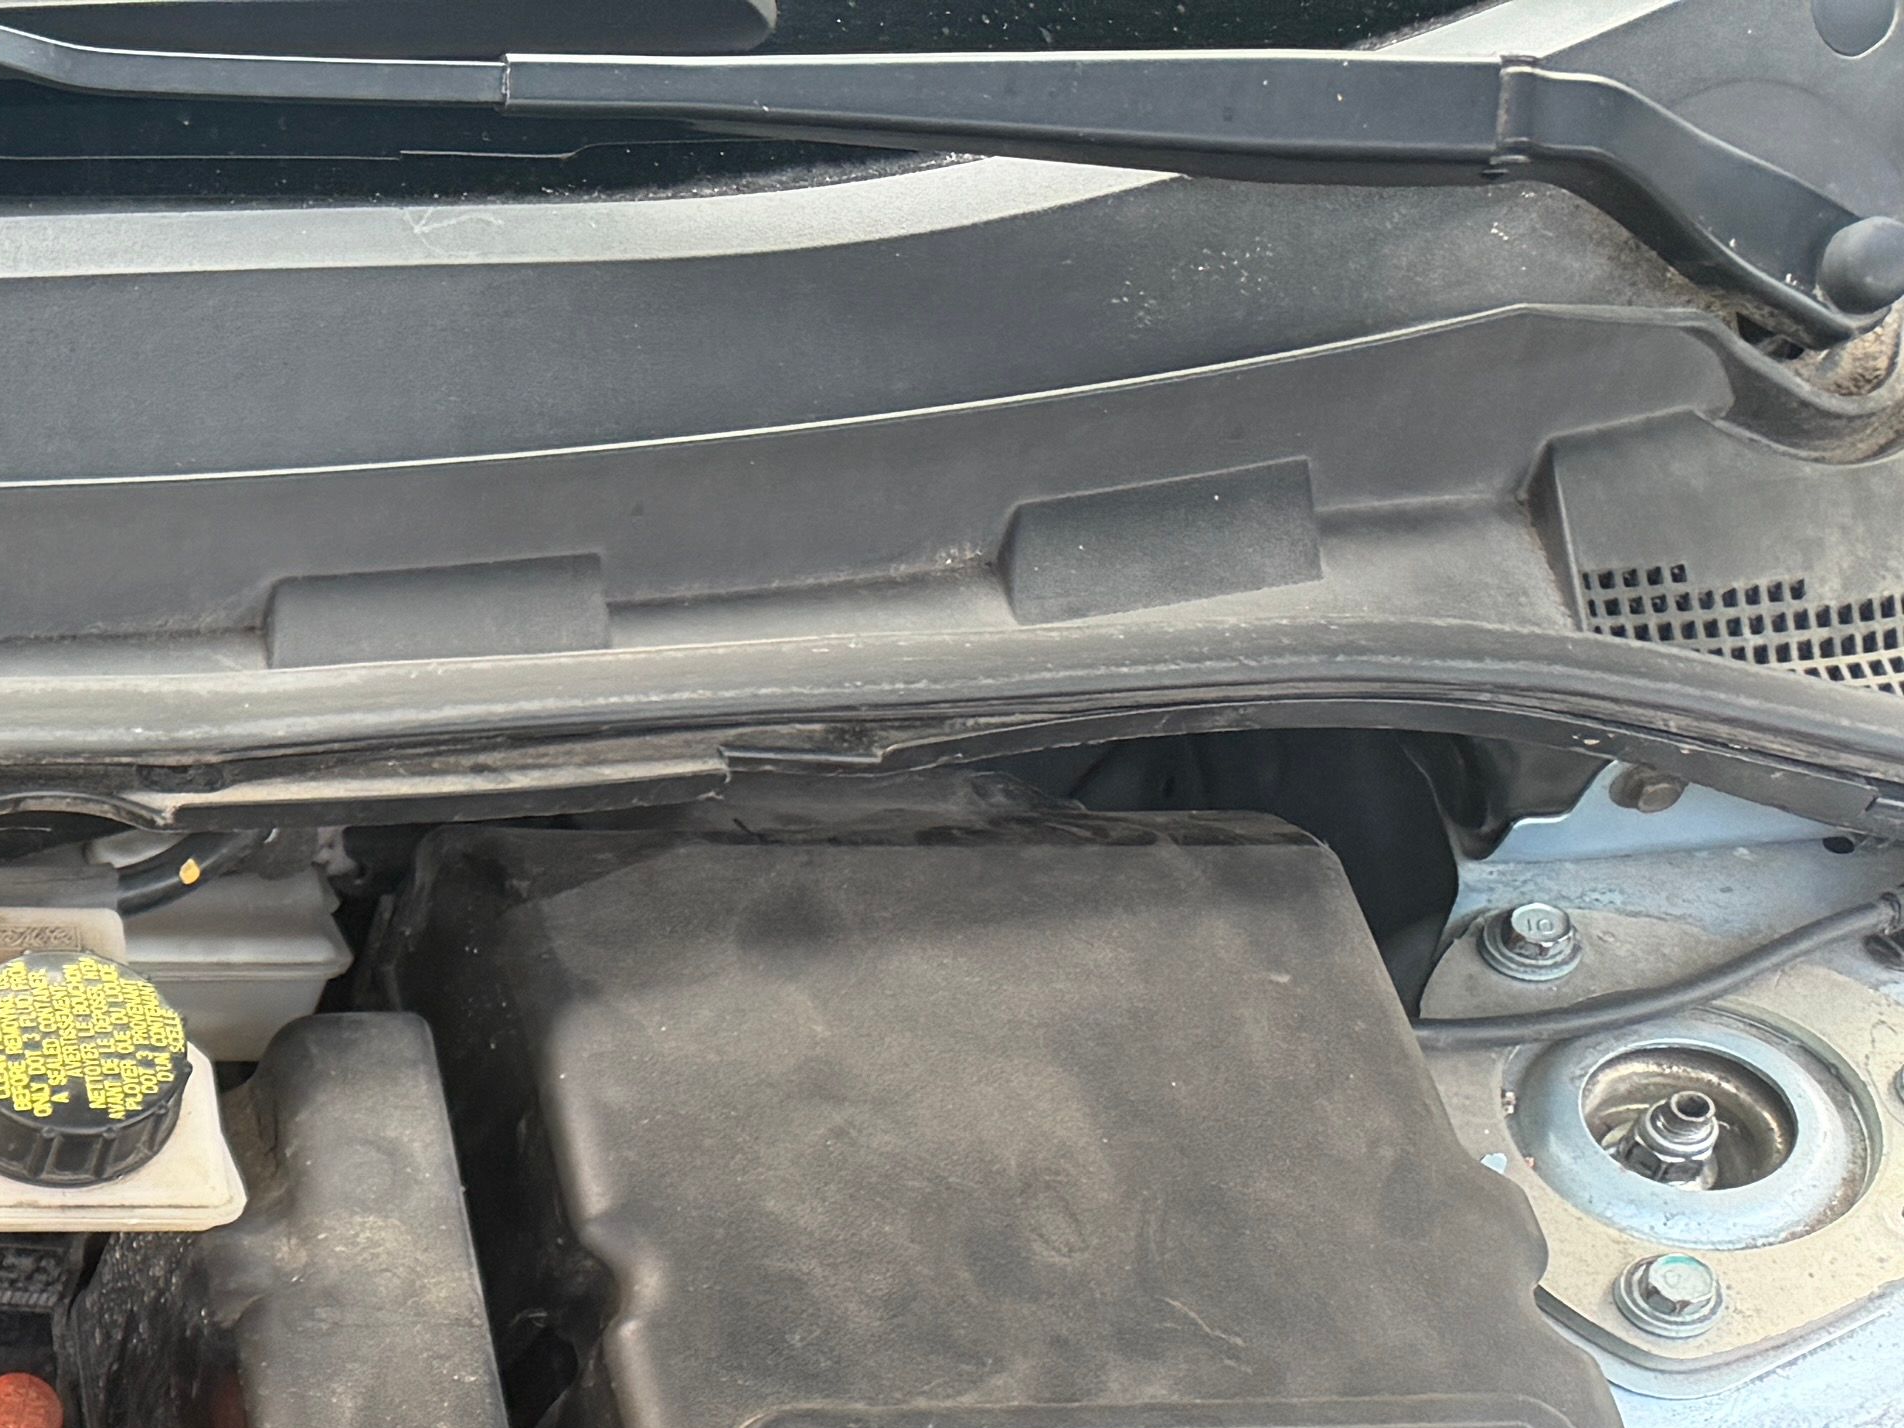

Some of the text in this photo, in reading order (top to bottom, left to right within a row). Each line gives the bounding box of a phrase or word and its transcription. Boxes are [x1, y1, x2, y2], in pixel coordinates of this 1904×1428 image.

[22, 1033, 40, 1041] 3
[75, 1021, 94, 1035] LE
[97, 1038, 115, 1051] LE
[136, 1051, 152, 1059] 3
[25, 1050, 45, 1074] DOT
[42, 1039, 67, 1084] SEALED
[7, 1060, 33, 1110] BEFORE
[79, 1043, 106, 1107] NETTOYER
[118, 1060, 143, 1108] PLOYER
[139, 1068, 158, 1092] DOT
[29, 1083, 53, 1116] ONLY
[51, 1091, 69, 1101] A
[103, 1081, 126, 1118] AVANT
